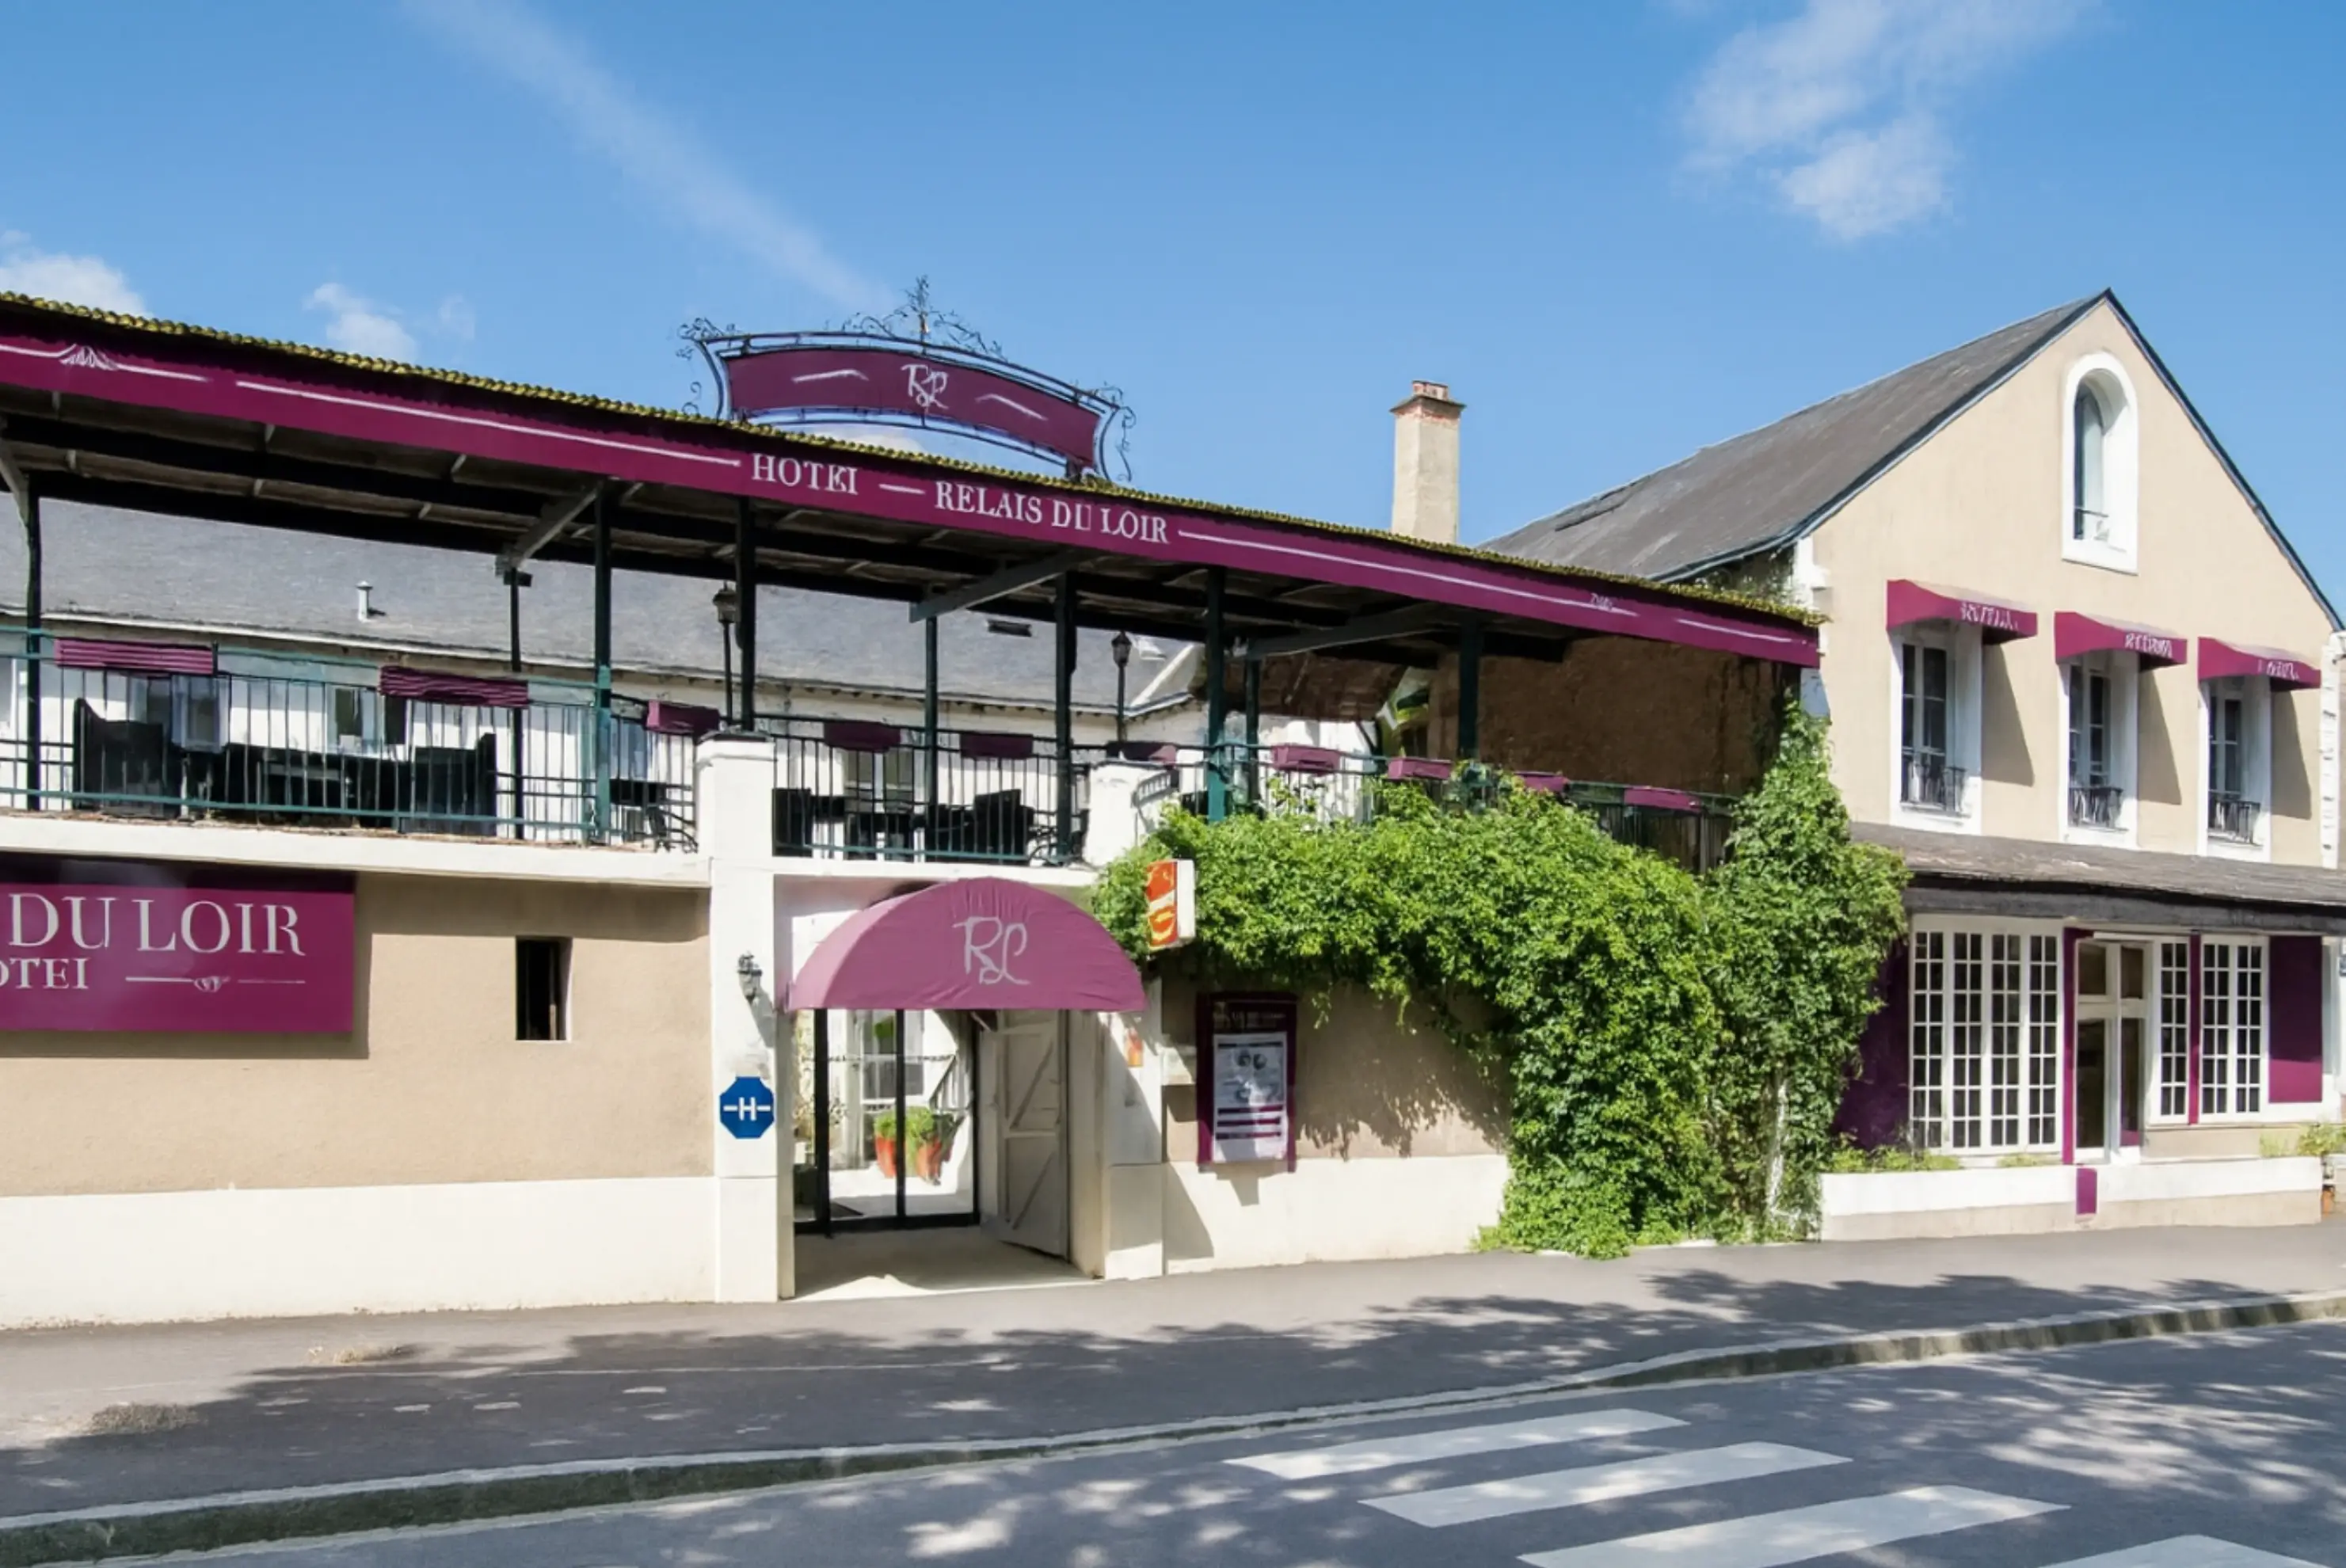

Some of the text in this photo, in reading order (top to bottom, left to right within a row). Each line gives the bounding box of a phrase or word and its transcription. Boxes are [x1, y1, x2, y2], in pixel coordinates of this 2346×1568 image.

[935, 480, 1043, 524] RELAIS
[1051, 499, 1092, 531] DU
[1100, 508, 1171, 544] LOIR
[8, 892, 306, 956] DU LOIR
[738, 1097, 757, 1121] H
